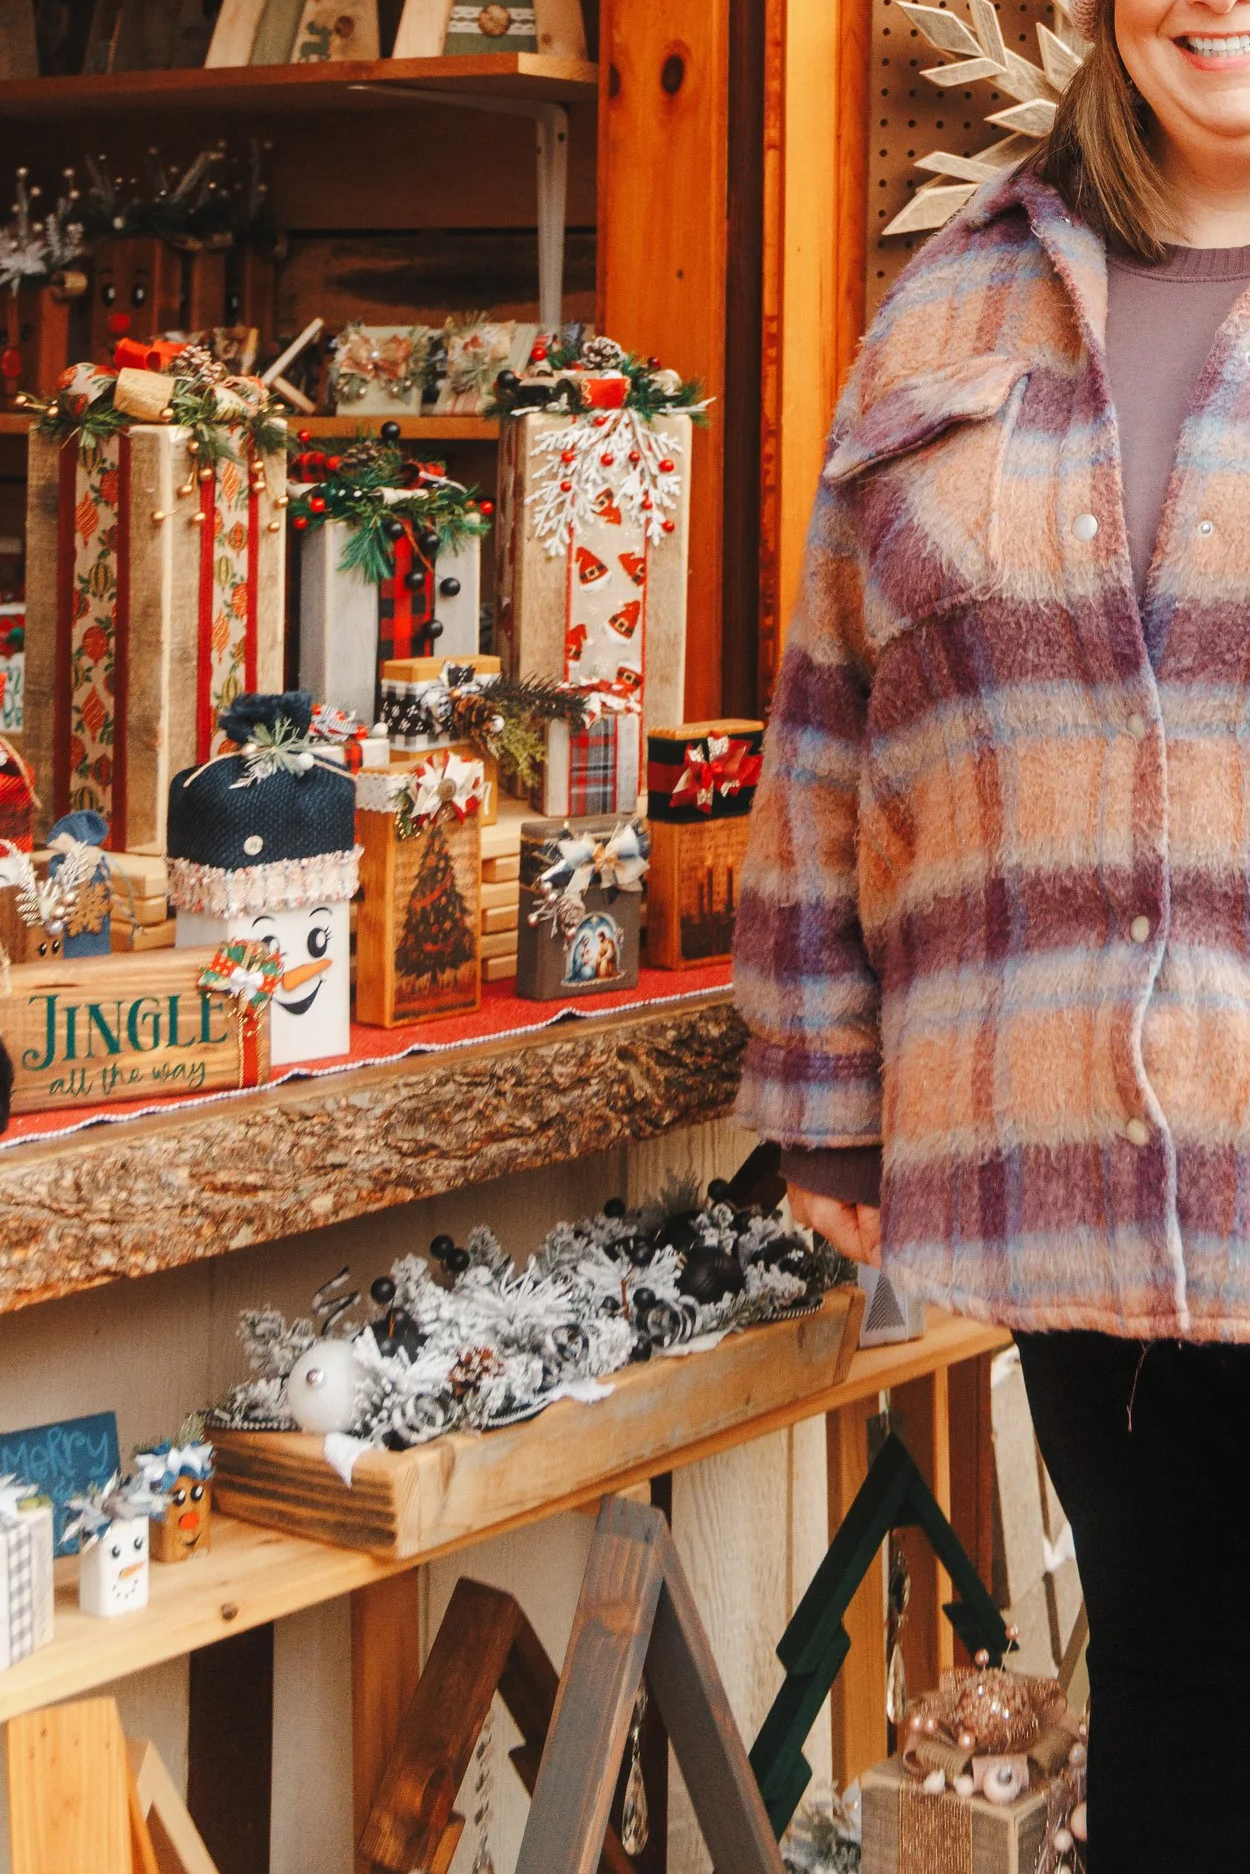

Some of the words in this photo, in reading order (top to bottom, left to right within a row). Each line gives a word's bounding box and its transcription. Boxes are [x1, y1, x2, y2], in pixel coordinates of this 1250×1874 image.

[21, 992, 229, 1072] JINGLE
[49, 1067, 94, 1099] all
[102, 1062, 145, 1096] the
[152, 1060, 207, 1088] way
